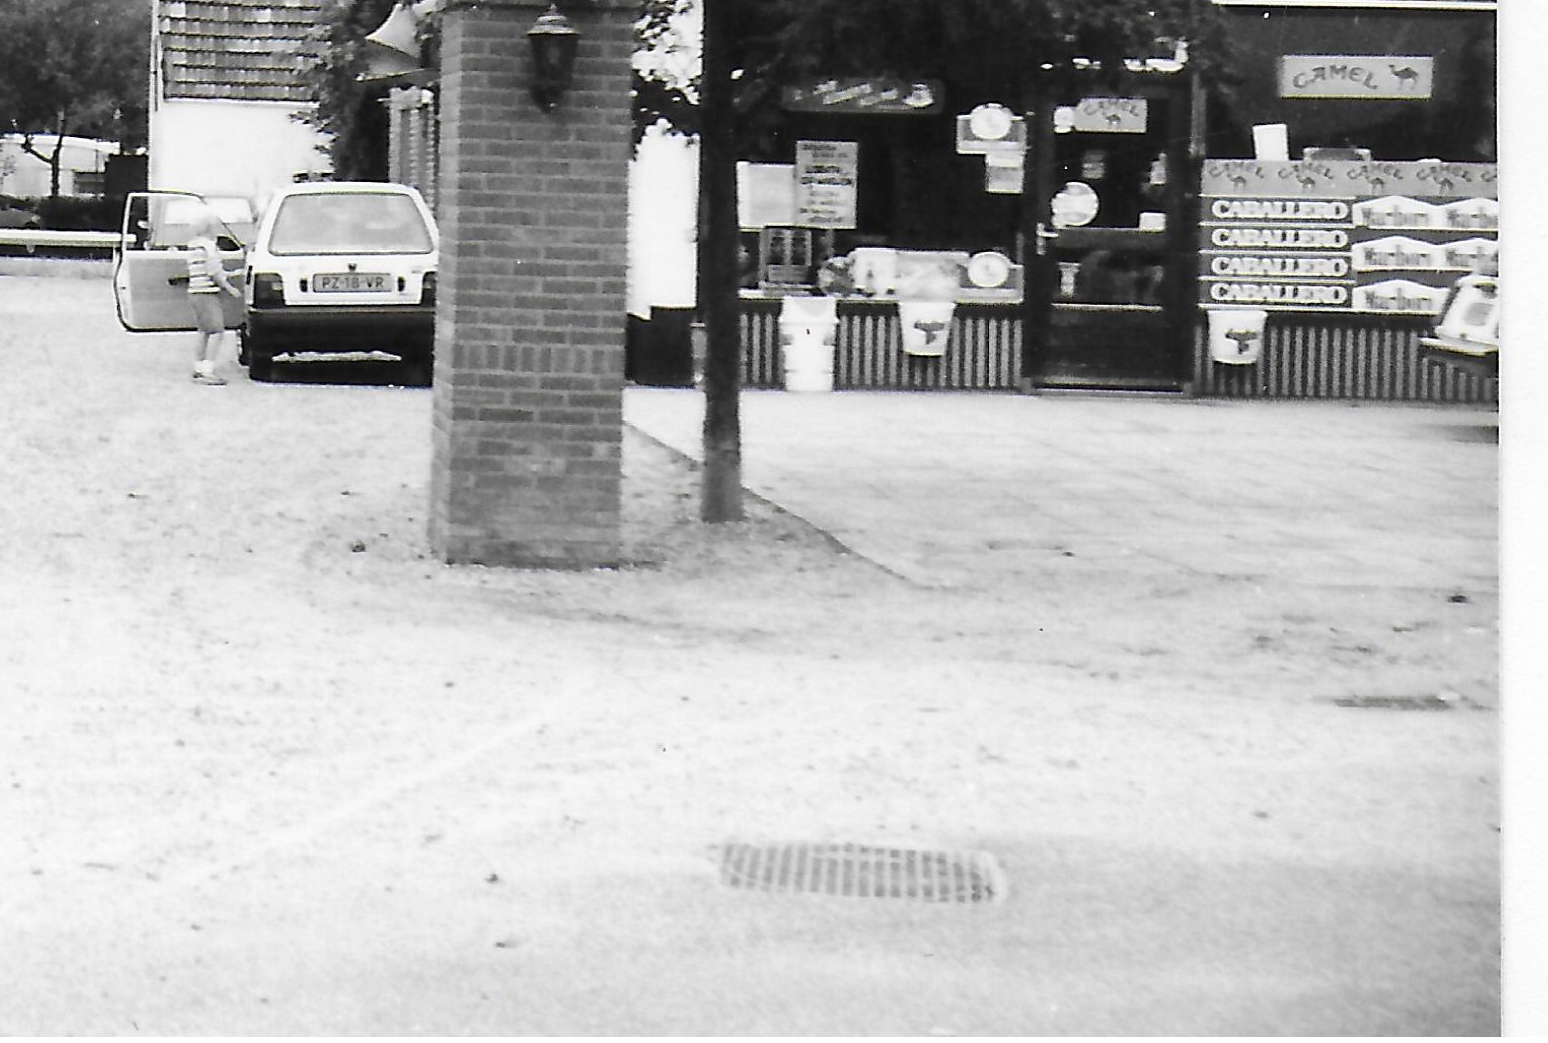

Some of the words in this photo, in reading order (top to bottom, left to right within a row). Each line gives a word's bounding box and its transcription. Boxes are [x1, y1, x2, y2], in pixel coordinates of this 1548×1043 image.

[1293, 64, 1379, 90] CAMEL
[1212, 200, 1349, 219] CABALLERO
[1212, 228, 1348, 248] CABALLERO
[1211, 257, 1348, 277] CABALLERO
[1210, 283, 1348, 304] CABALLERO
